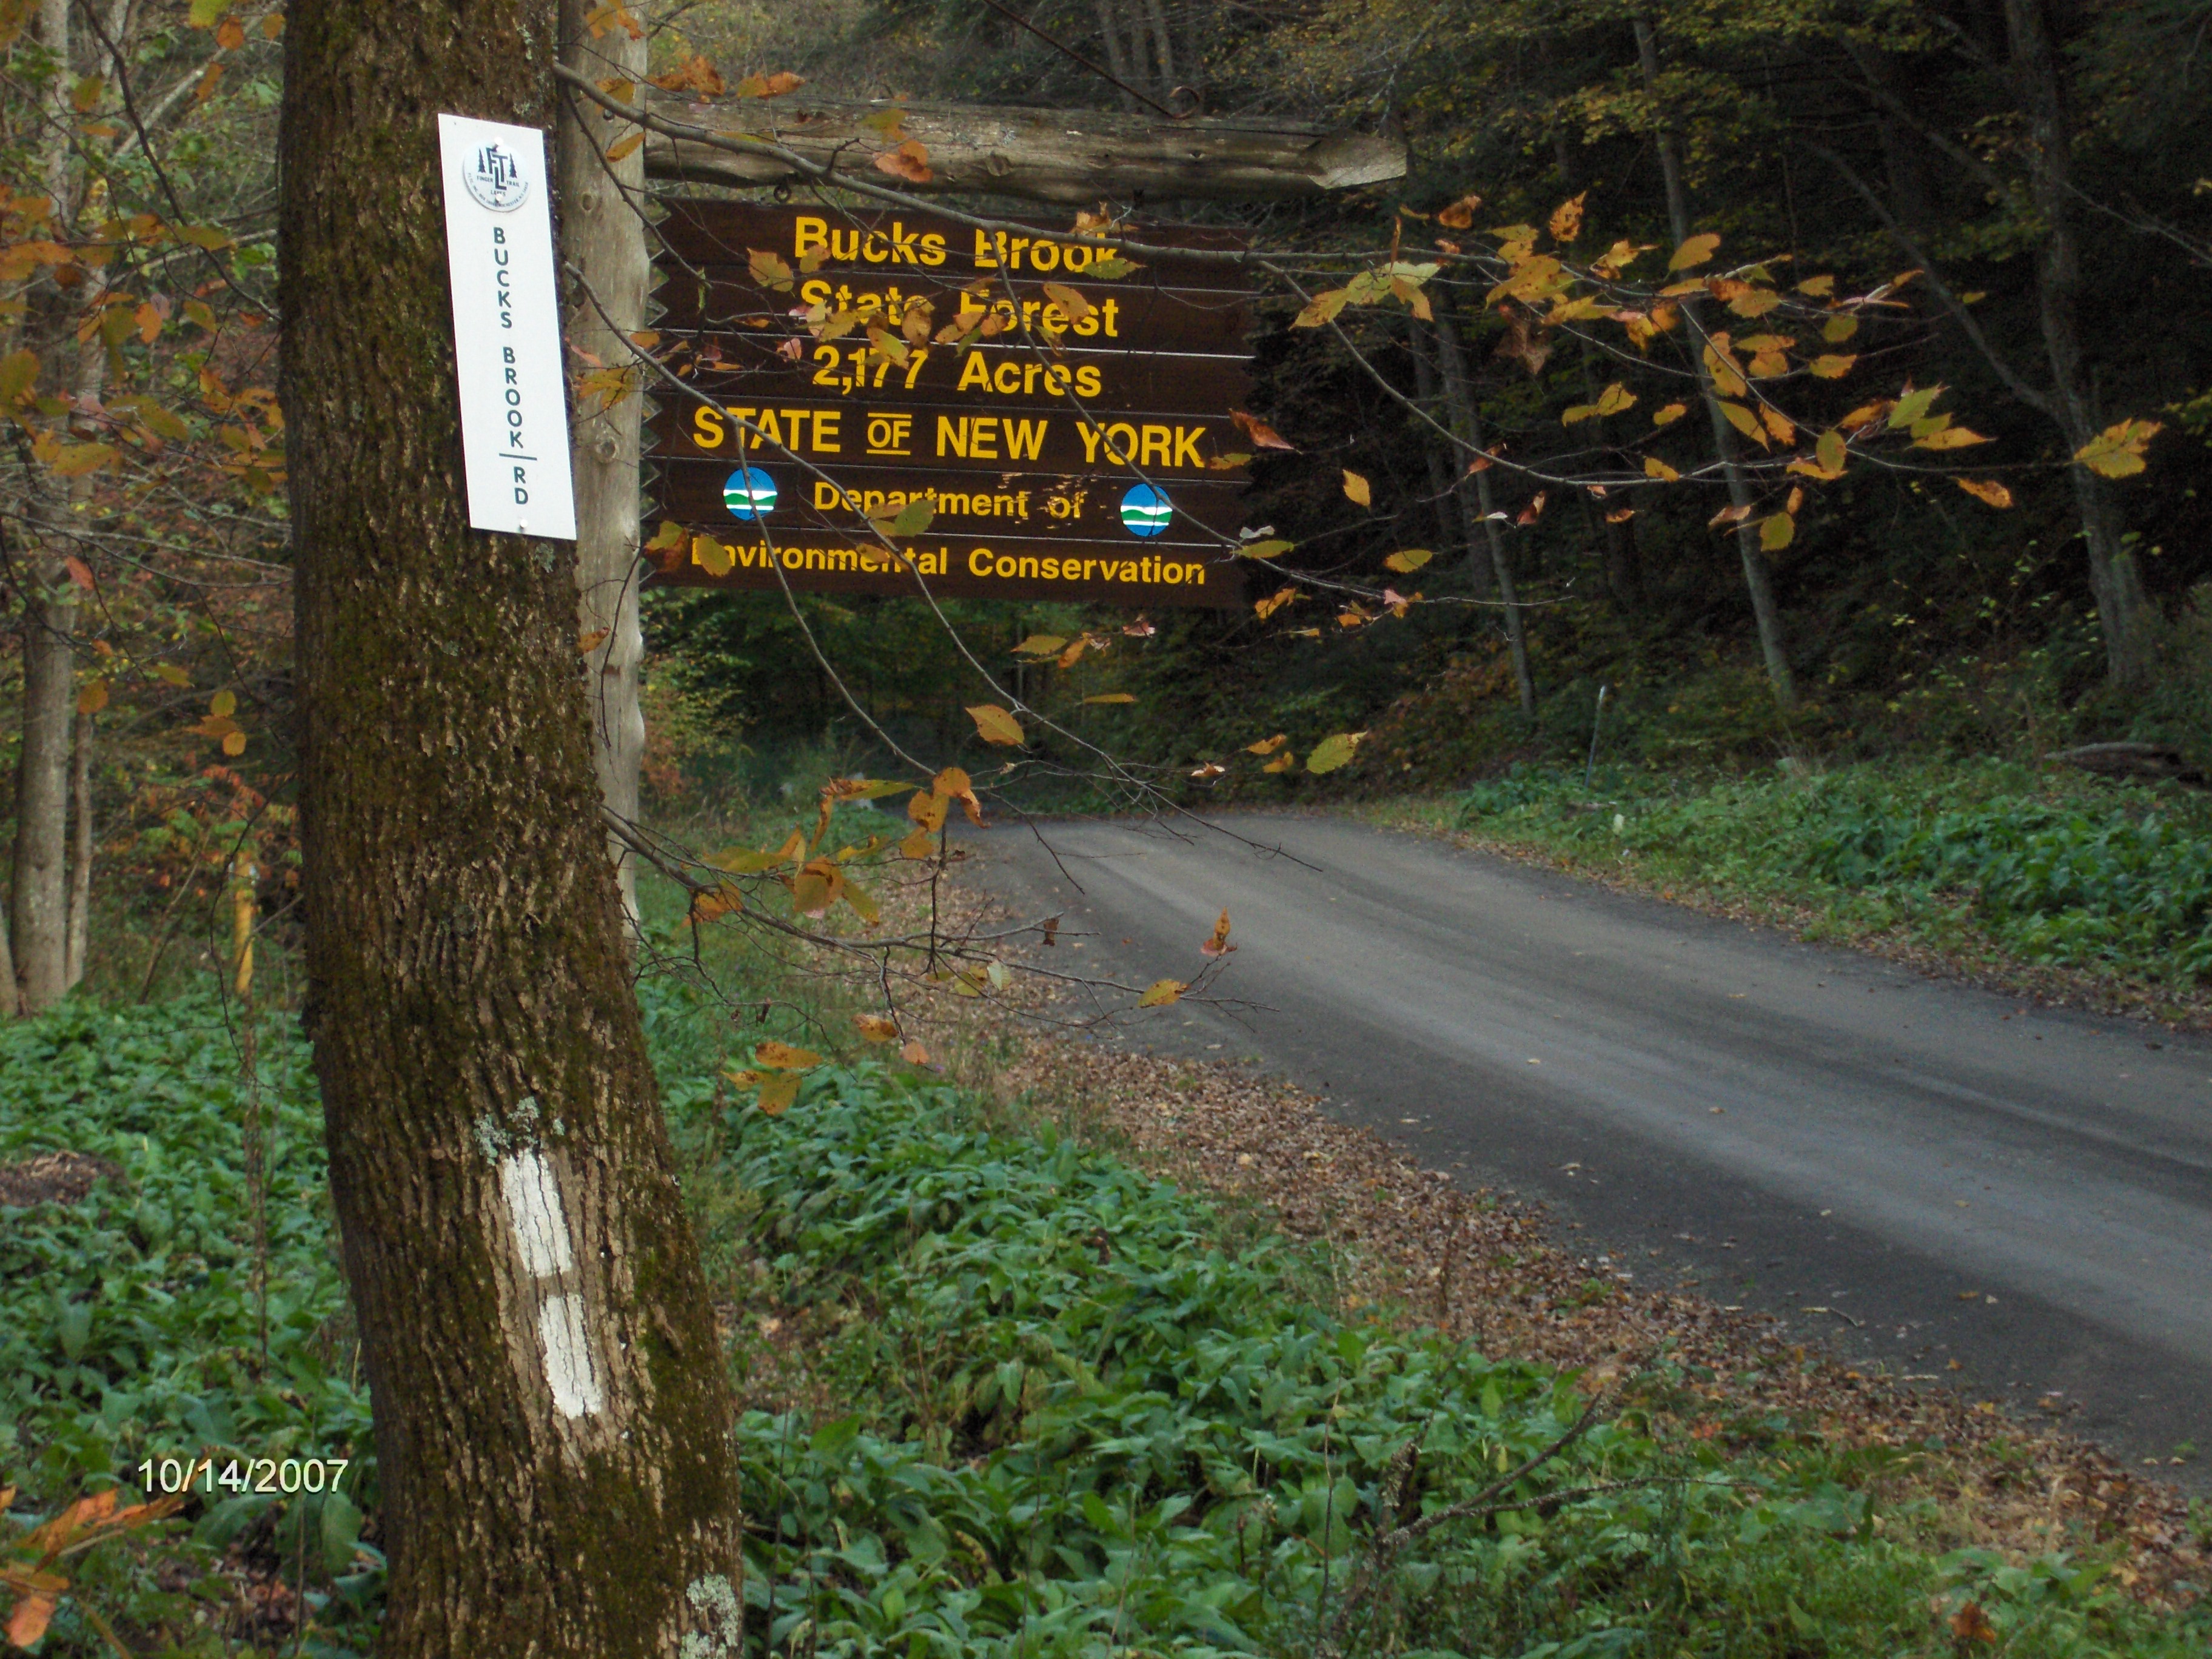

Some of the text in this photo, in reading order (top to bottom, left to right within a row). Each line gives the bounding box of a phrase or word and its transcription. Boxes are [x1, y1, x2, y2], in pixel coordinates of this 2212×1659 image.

[794, 216, 946, 266] Bucks
[493, 227, 528, 504] BUCKS BROOK RD
[957, 351, 1102, 397] Acres
[694, 406, 1205, 467] STATE OF NEW YORK
[1047, 492, 1084, 519] of
[969, 548, 1205, 585] Conservation
